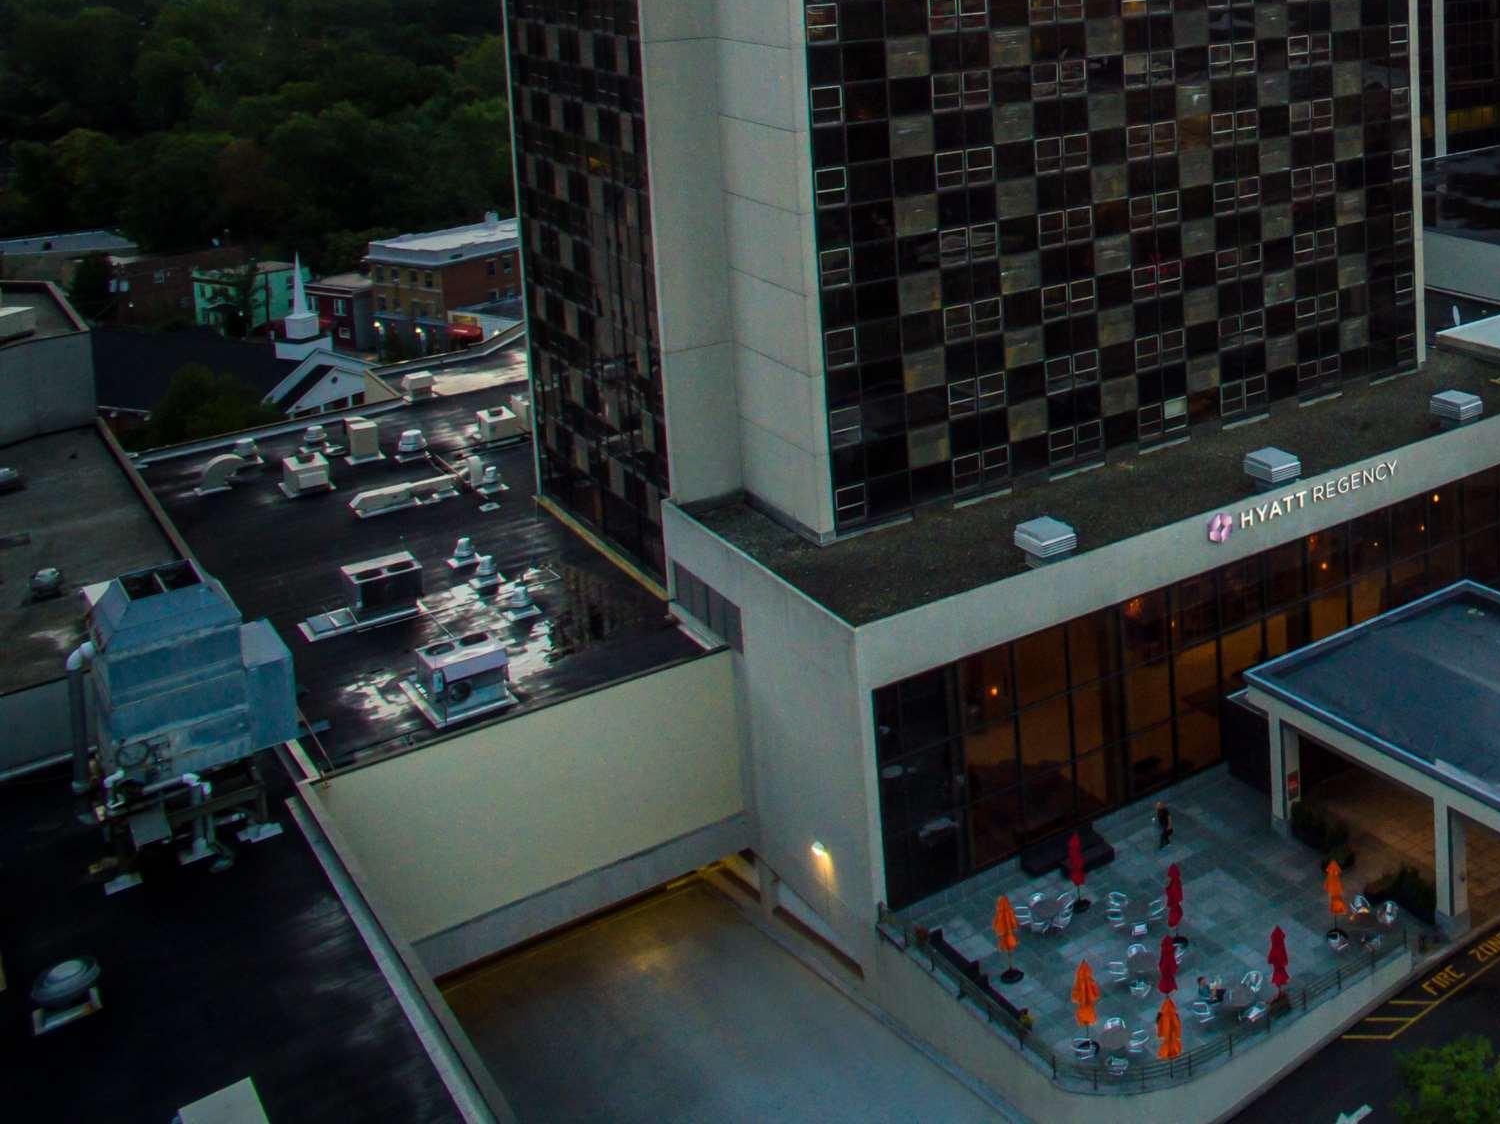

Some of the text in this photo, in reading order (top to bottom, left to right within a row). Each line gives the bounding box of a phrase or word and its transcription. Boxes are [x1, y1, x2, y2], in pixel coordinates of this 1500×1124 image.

[1240, 460, 1398, 528] HYATT REGENCY
[1422, 964, 1465, 995] FIRE
